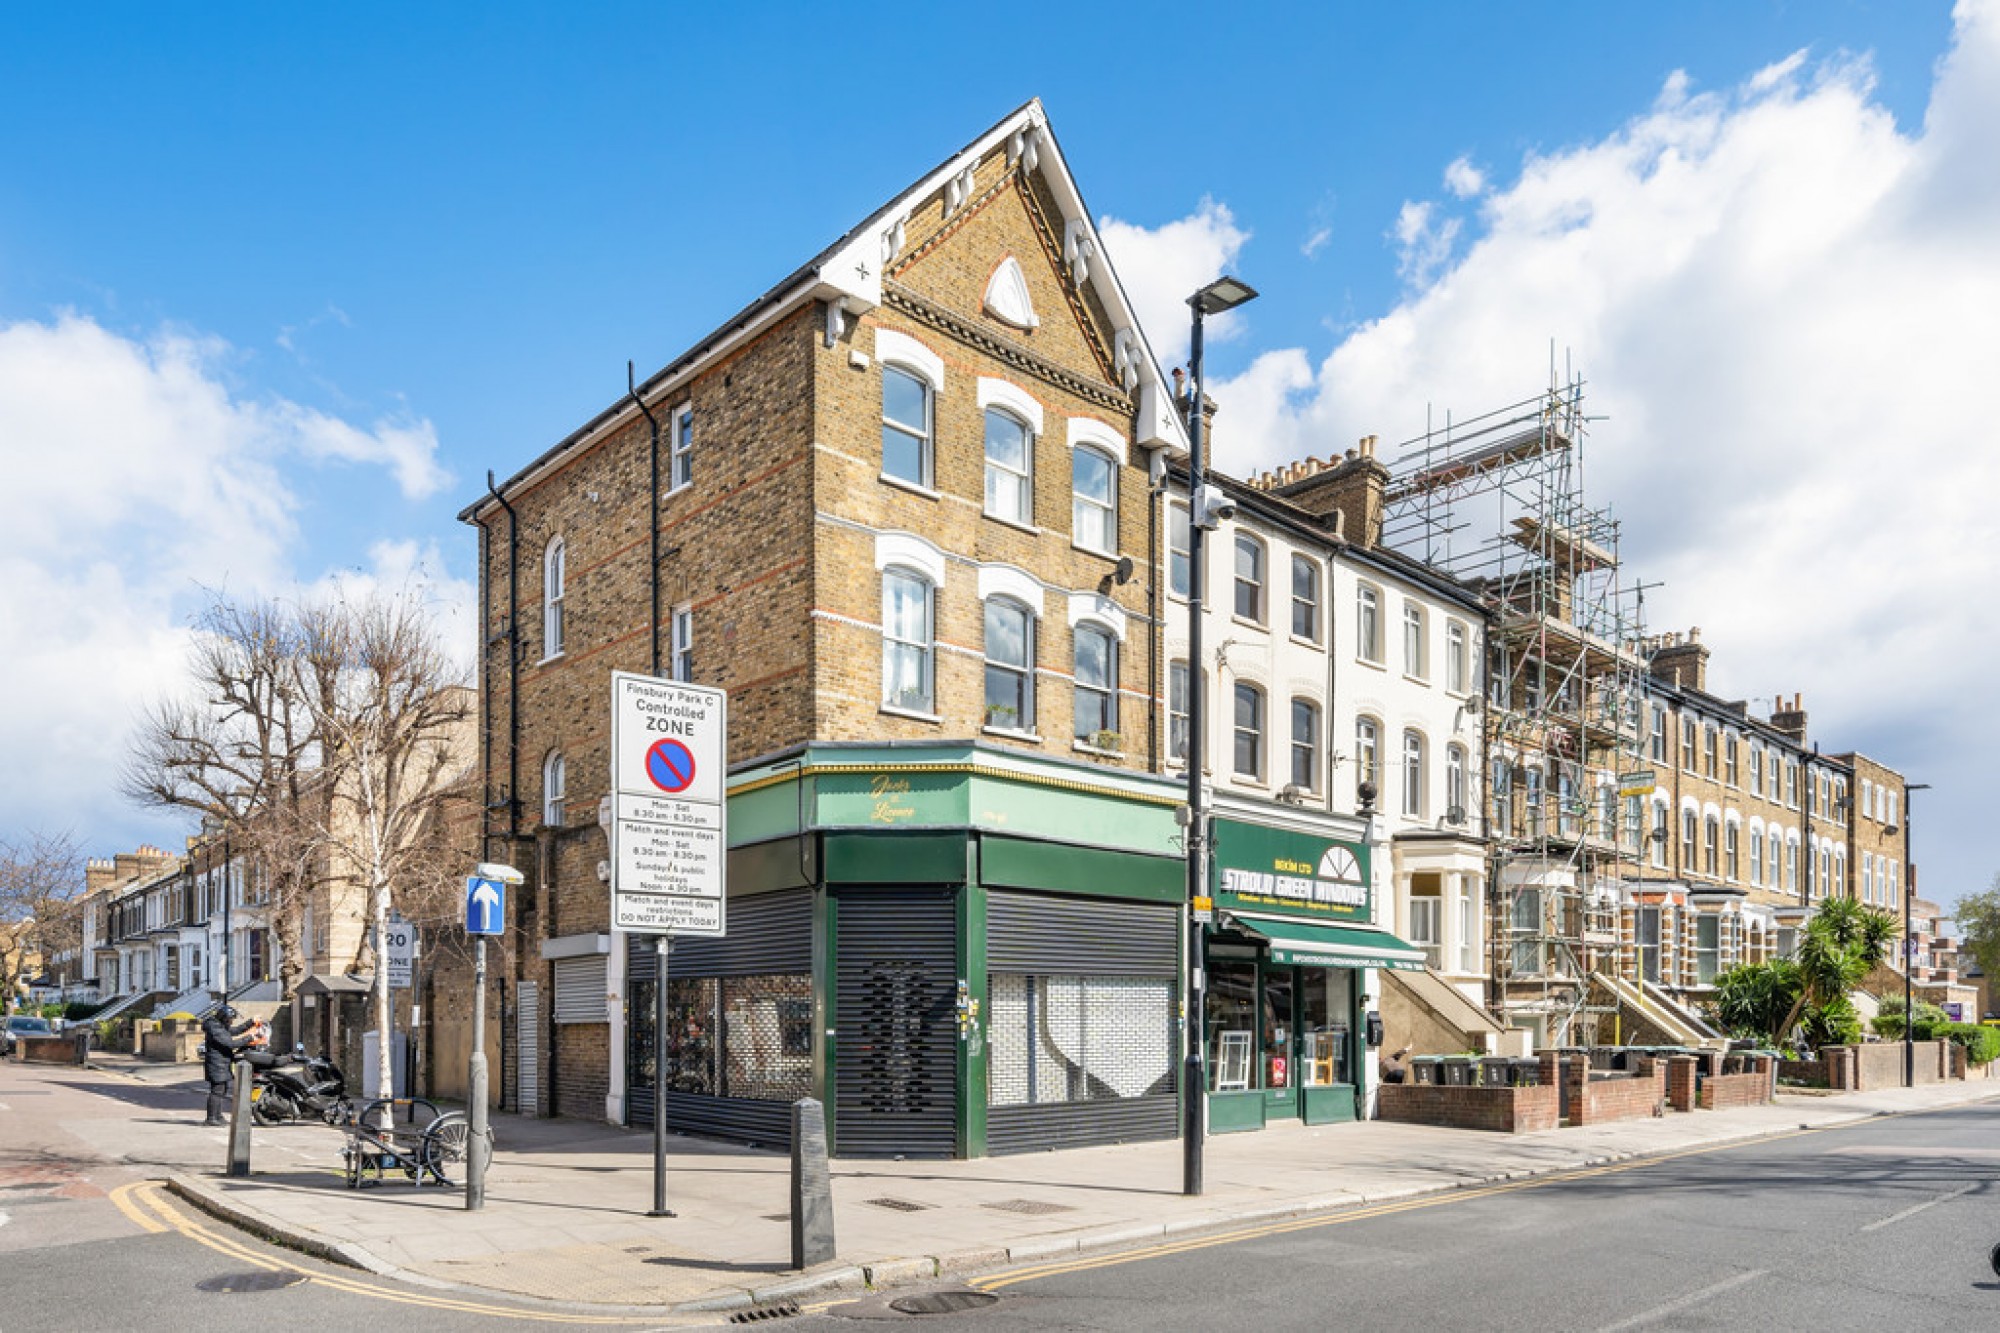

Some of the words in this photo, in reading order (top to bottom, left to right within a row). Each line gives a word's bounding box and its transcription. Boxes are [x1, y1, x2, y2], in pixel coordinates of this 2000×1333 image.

[626, 682, 674, 701] Finsbury
[677, 691, 702, 704] Park
[704, 696, 714, 707] C
[636, 698, 706, 720] Controlled
[646, 716, 695, 737] ZONE
[652, 800, 669, 810] Mon
[675, 803, 690, 812] Sat
[625, 823, 651, 833] Match
[654, 828, 669, 836] and
[671, 830, 693, 838] event
[695, 831, 714, 841] days
[652, 838, 669, 847] Mon
[675, 840, 690, 849] Sat
[681, 866, 705, 875] public
[1299, 862, 1312, 875] LTD
[653, 873, 688, 885] holidays
[640, 882, 662, 890] Noon
[1221, 867, 1273, 894] STROUD
[1274, 874, 1313, 899] GREEN
[1314, 880, 1368, 906] WINDOWS
[625, 895, 651, 904] Match
[654, 898, 669, 906] and
[671, 899, 693, 907] event
[695, 901, 714, 909] days
[646, 907, 693, 916] restrictions
[621, 913, 635, 921] DO
[637, 914, 655, 922] NOT
[658, 915, 686, 924] APPLY
[689, 917, 717, 925] TODAY
[385, 932, 407, 947] 20
[387, 956, 409, 967] ONE
